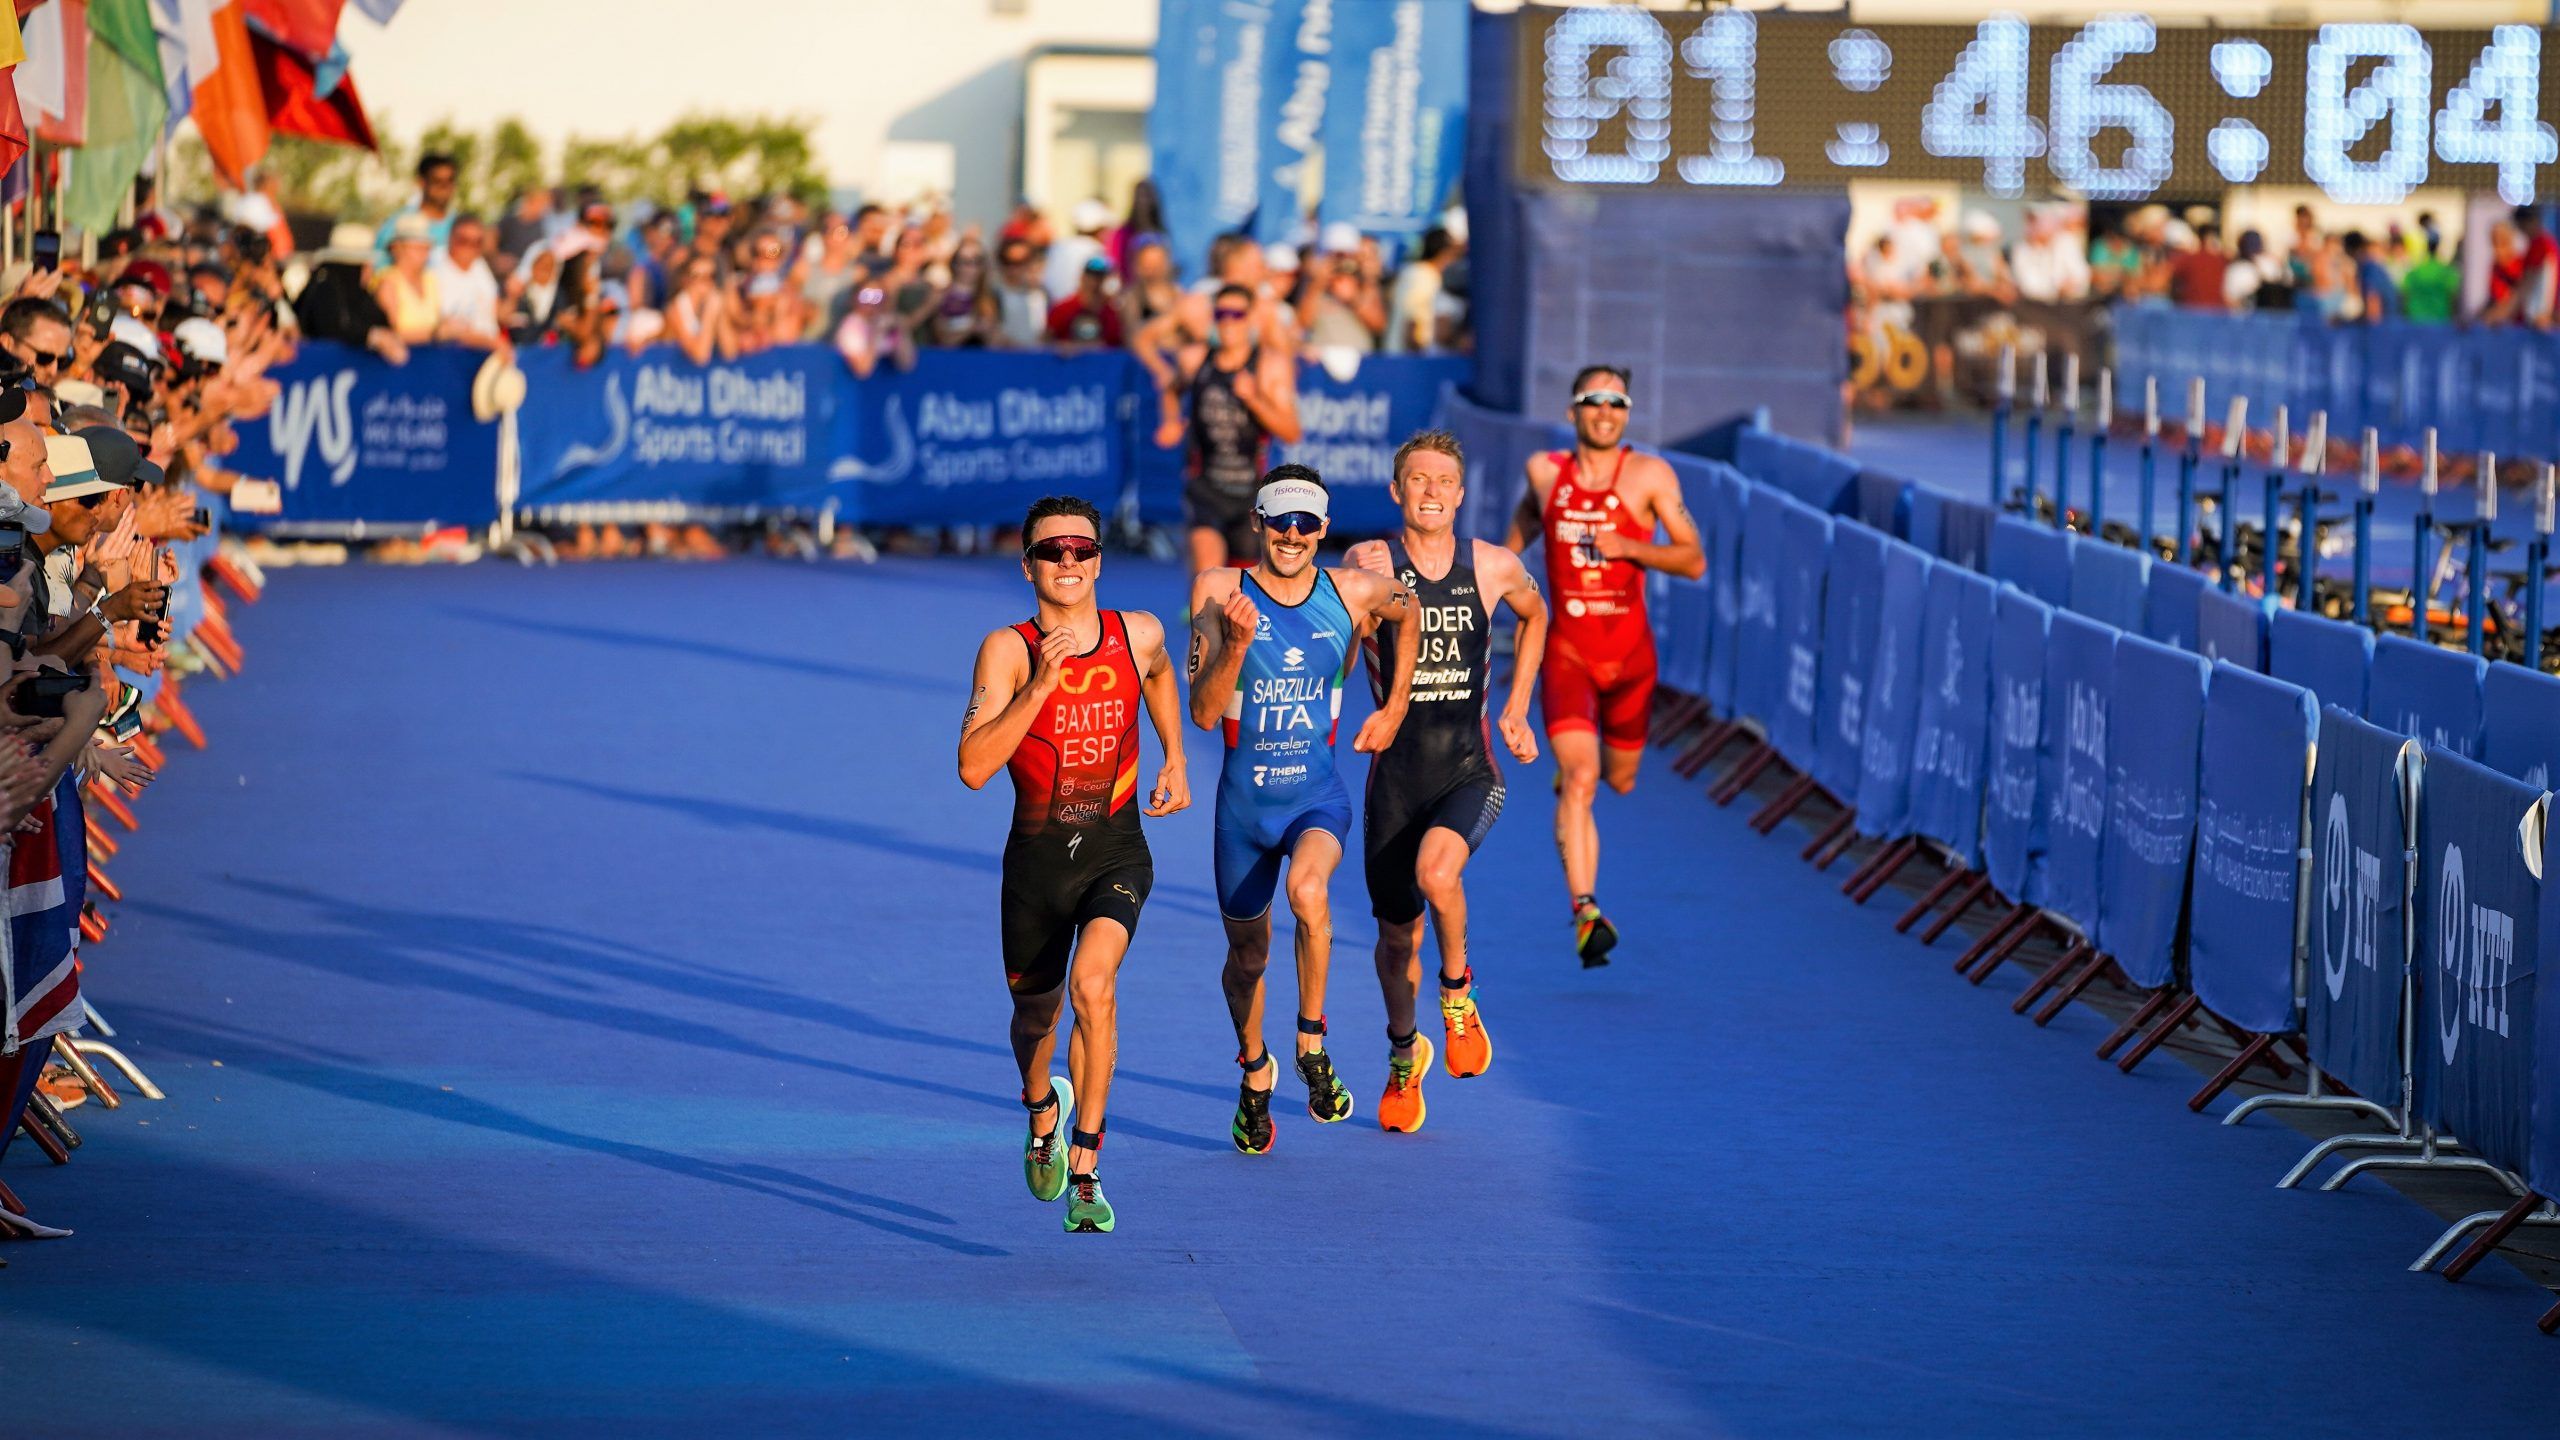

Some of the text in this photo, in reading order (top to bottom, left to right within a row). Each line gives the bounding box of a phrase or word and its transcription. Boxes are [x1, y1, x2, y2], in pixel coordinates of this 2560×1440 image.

[633, 364, 806, 421] Abu Dhabi
[917, 385, 1107, 441] Abu Dhabi
[632, 418, 806, 468] Sports Council
[919, 436, 1108, 488] Sports Council
[1274, 486, 1316, 498] fisiocrem
[1420, 605, 1475, 632] IDER
[1252, 677, 1325, 704] SARZILLA
[1054, 699, 1125, 734] BAXTER
[1259, 704, 1314, 733] ITA
[1062, 735, 1117, 768] ESP
[1255, 735, 1311, 751] dorelan
[1268, 774, 1307, 786] energia
[1270, 765, 1307, 777] THEMA
[1083, 782, 1111, 791] Ceuta
[1060, 810, 1099, 822] Garden
[1061, 801, 1101, 814] Albir
[2355, 846, 2381, 972] NTT
[2468, 902, 2514, 1039] NTT
